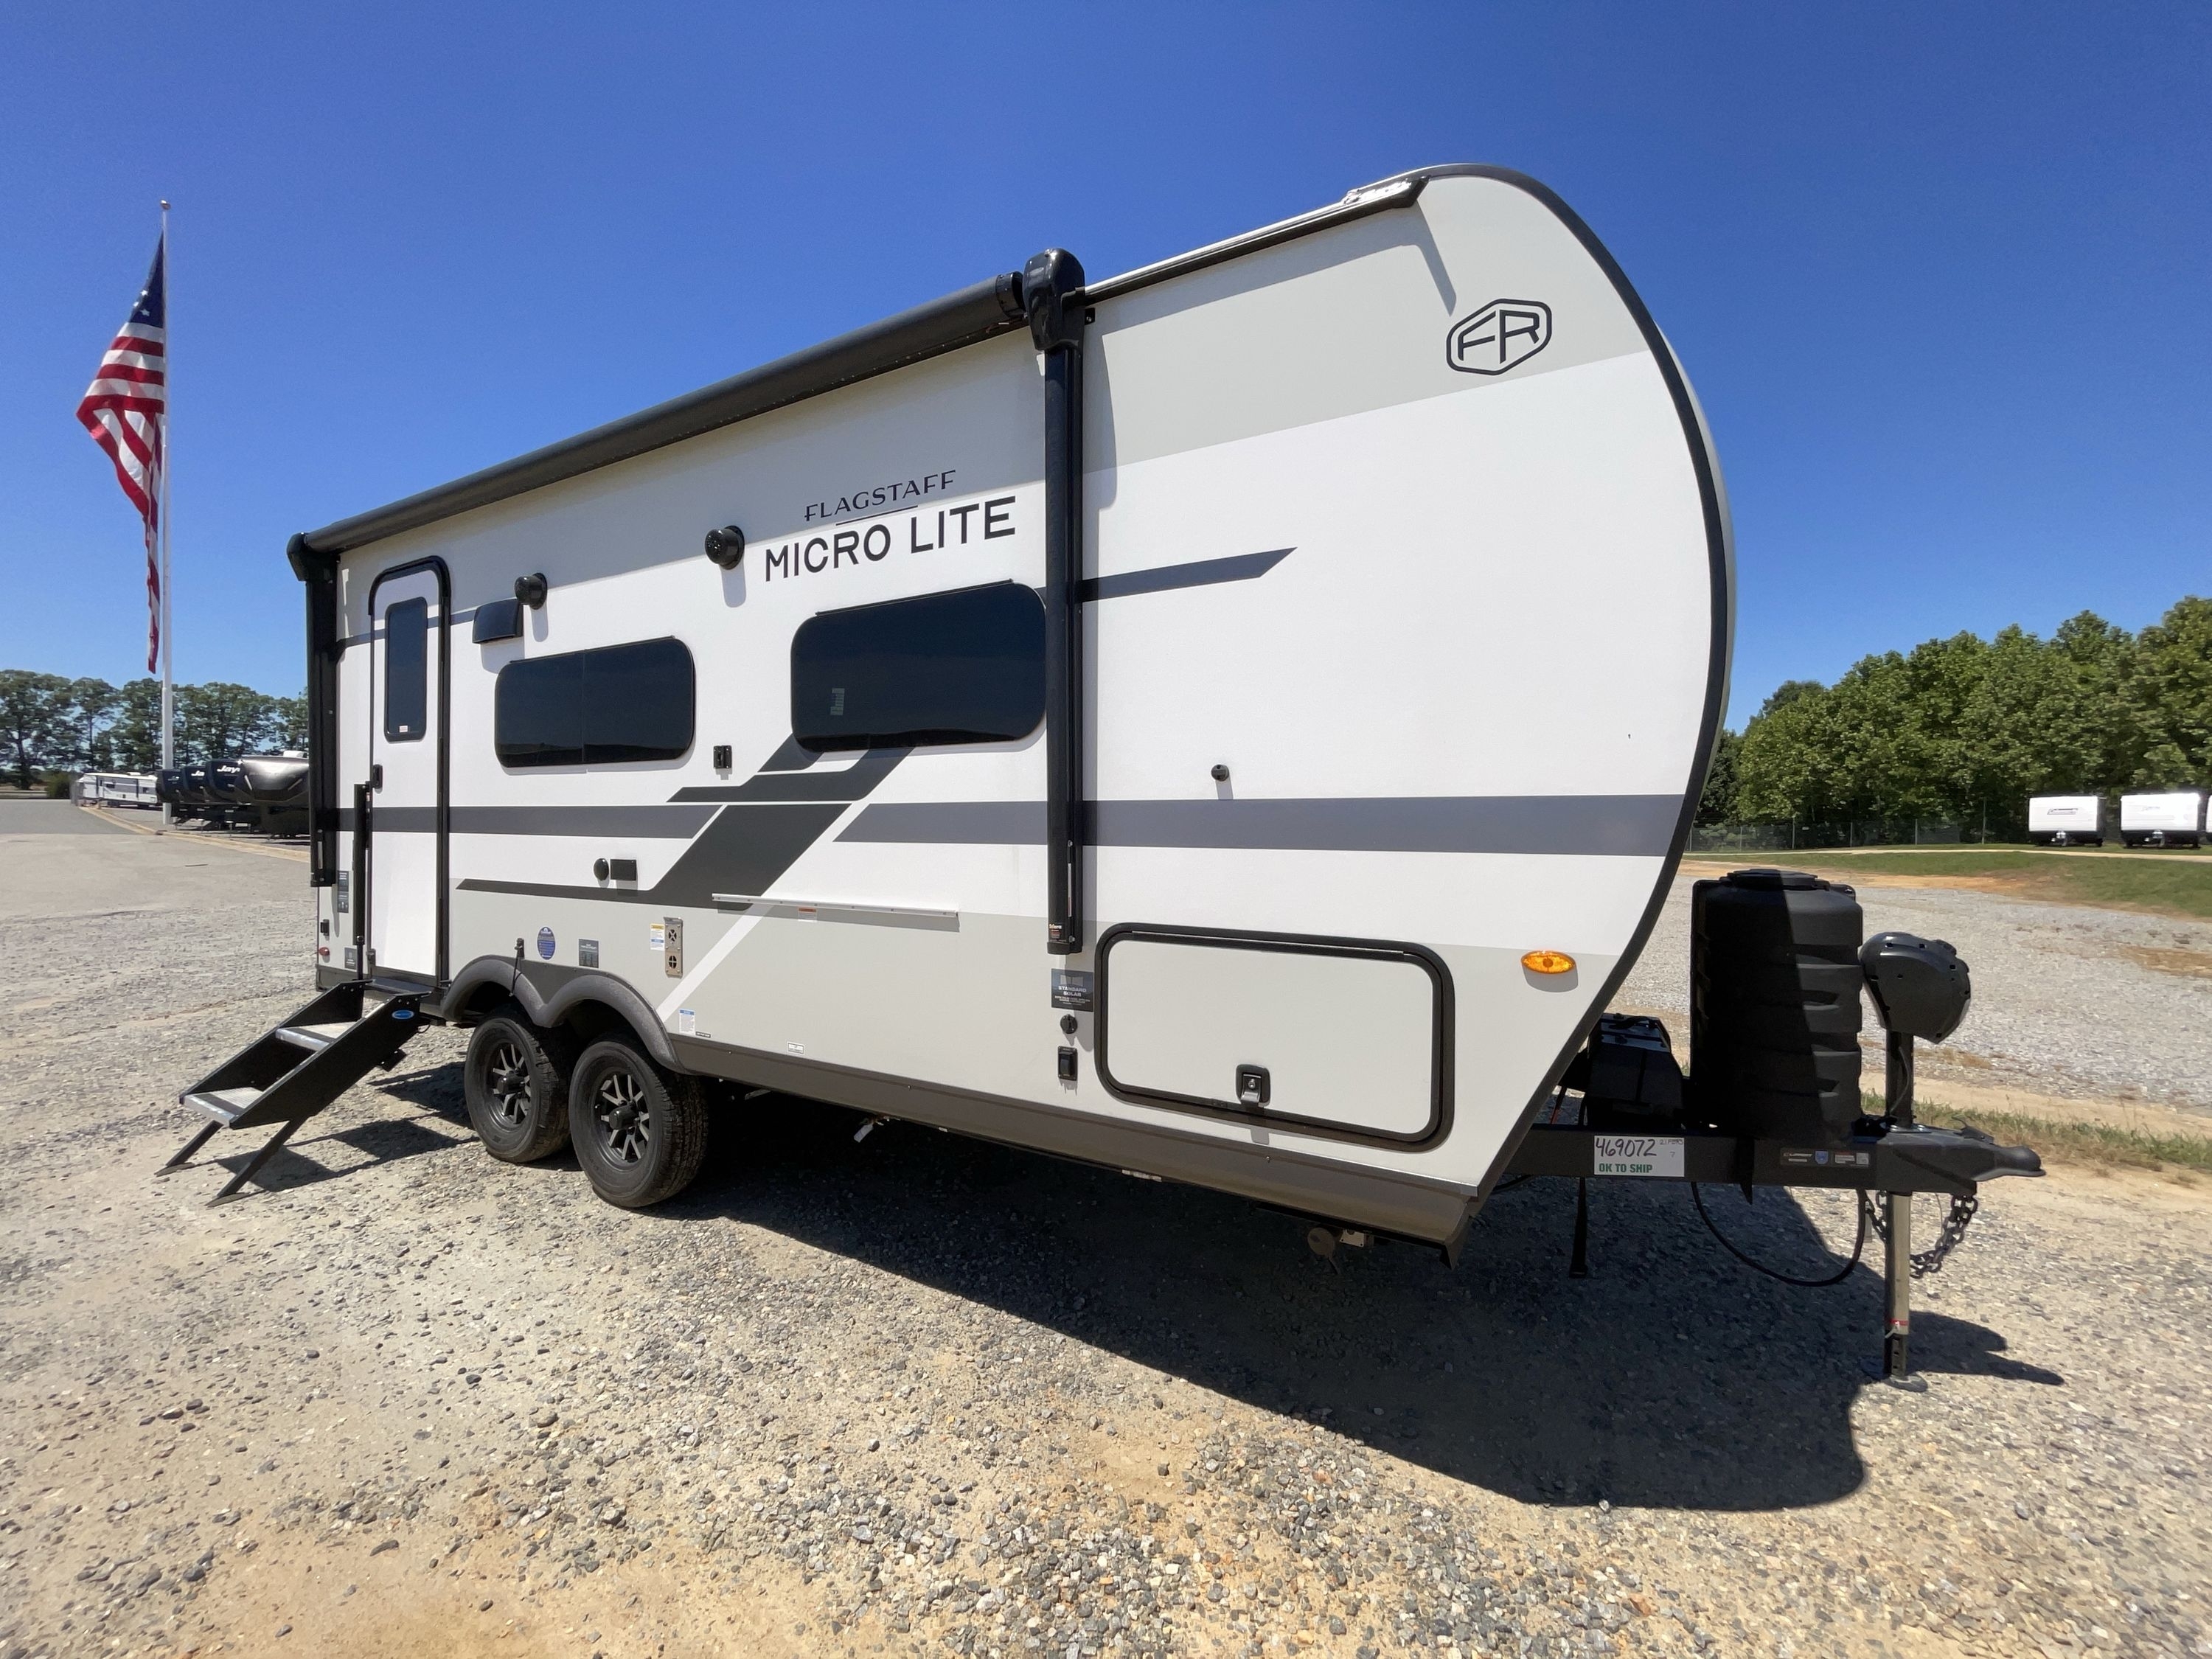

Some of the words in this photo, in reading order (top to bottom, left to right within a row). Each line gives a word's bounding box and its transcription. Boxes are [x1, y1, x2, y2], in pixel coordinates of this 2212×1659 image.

[804, 469, 956, 522] FLAGSTAFF
[765, 524, 891, 582] MICRO
[911, 495, 1015, 554] LITE
[1595, 1136, 1657, 1158] 469072
[1599, 1163, 1613, 1172] OK
[1614, 1164, 1627, 1173] TO
[1630, 1164, 1653, 1174] SHIP
